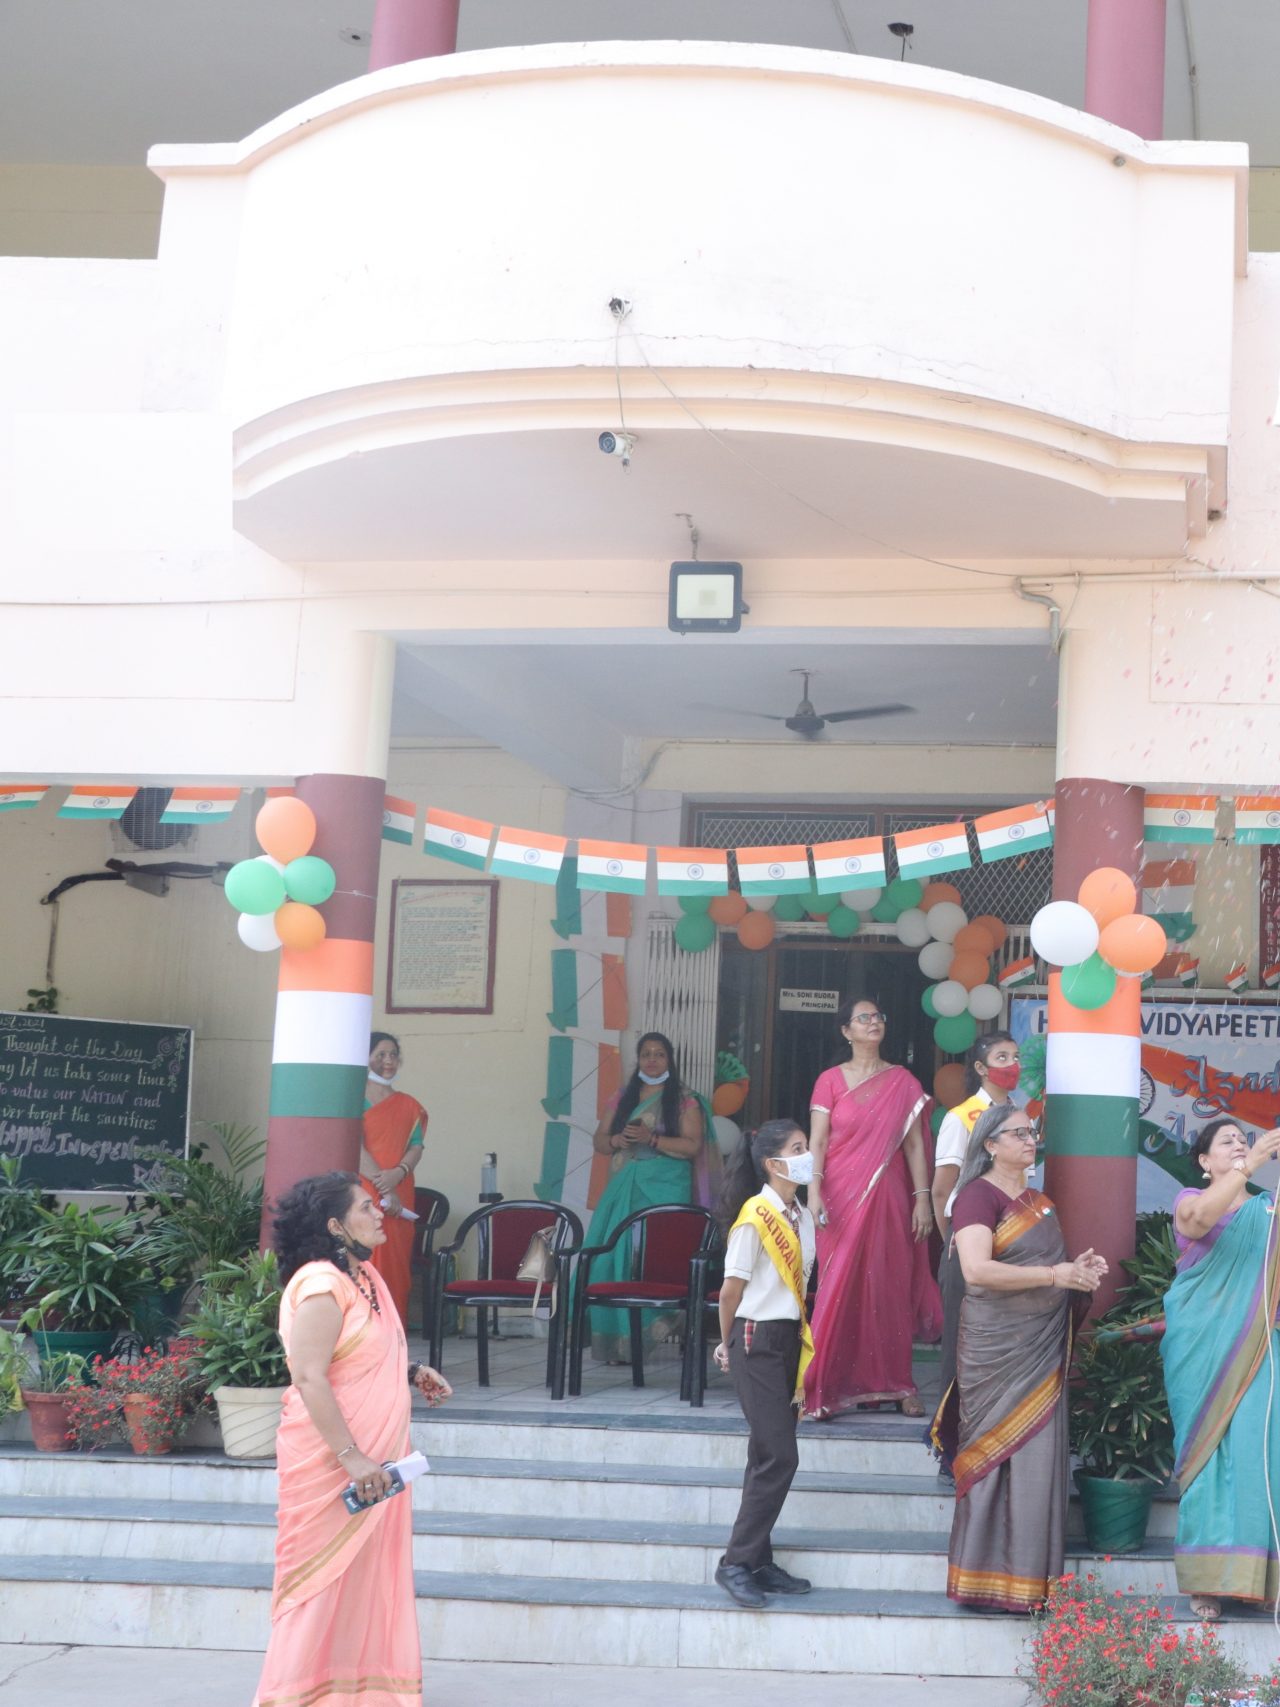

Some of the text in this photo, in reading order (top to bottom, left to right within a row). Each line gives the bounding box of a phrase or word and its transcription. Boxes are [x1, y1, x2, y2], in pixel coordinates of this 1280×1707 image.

[2, 1034, 144, 1059] Thought of the Day
[20, 1056, 38, 1077] let
[44, 1066, 60, 1077] us
[64, 1060, 91, 1080] take
[97, 1070, 130, 1082] some
[138, 1067, 166, 1086] time
[11, 1081, 48, 1100] value
[53, 1089, 76, 1100] our
[80, 1084, 129, 1105] NATION
[133, 1090, 161, 1108] and
[28, 1103, 67, 1127] forget
[71, 1105, 90, 1122] the
[755, 1204, 796, 1270] CULTURAL
